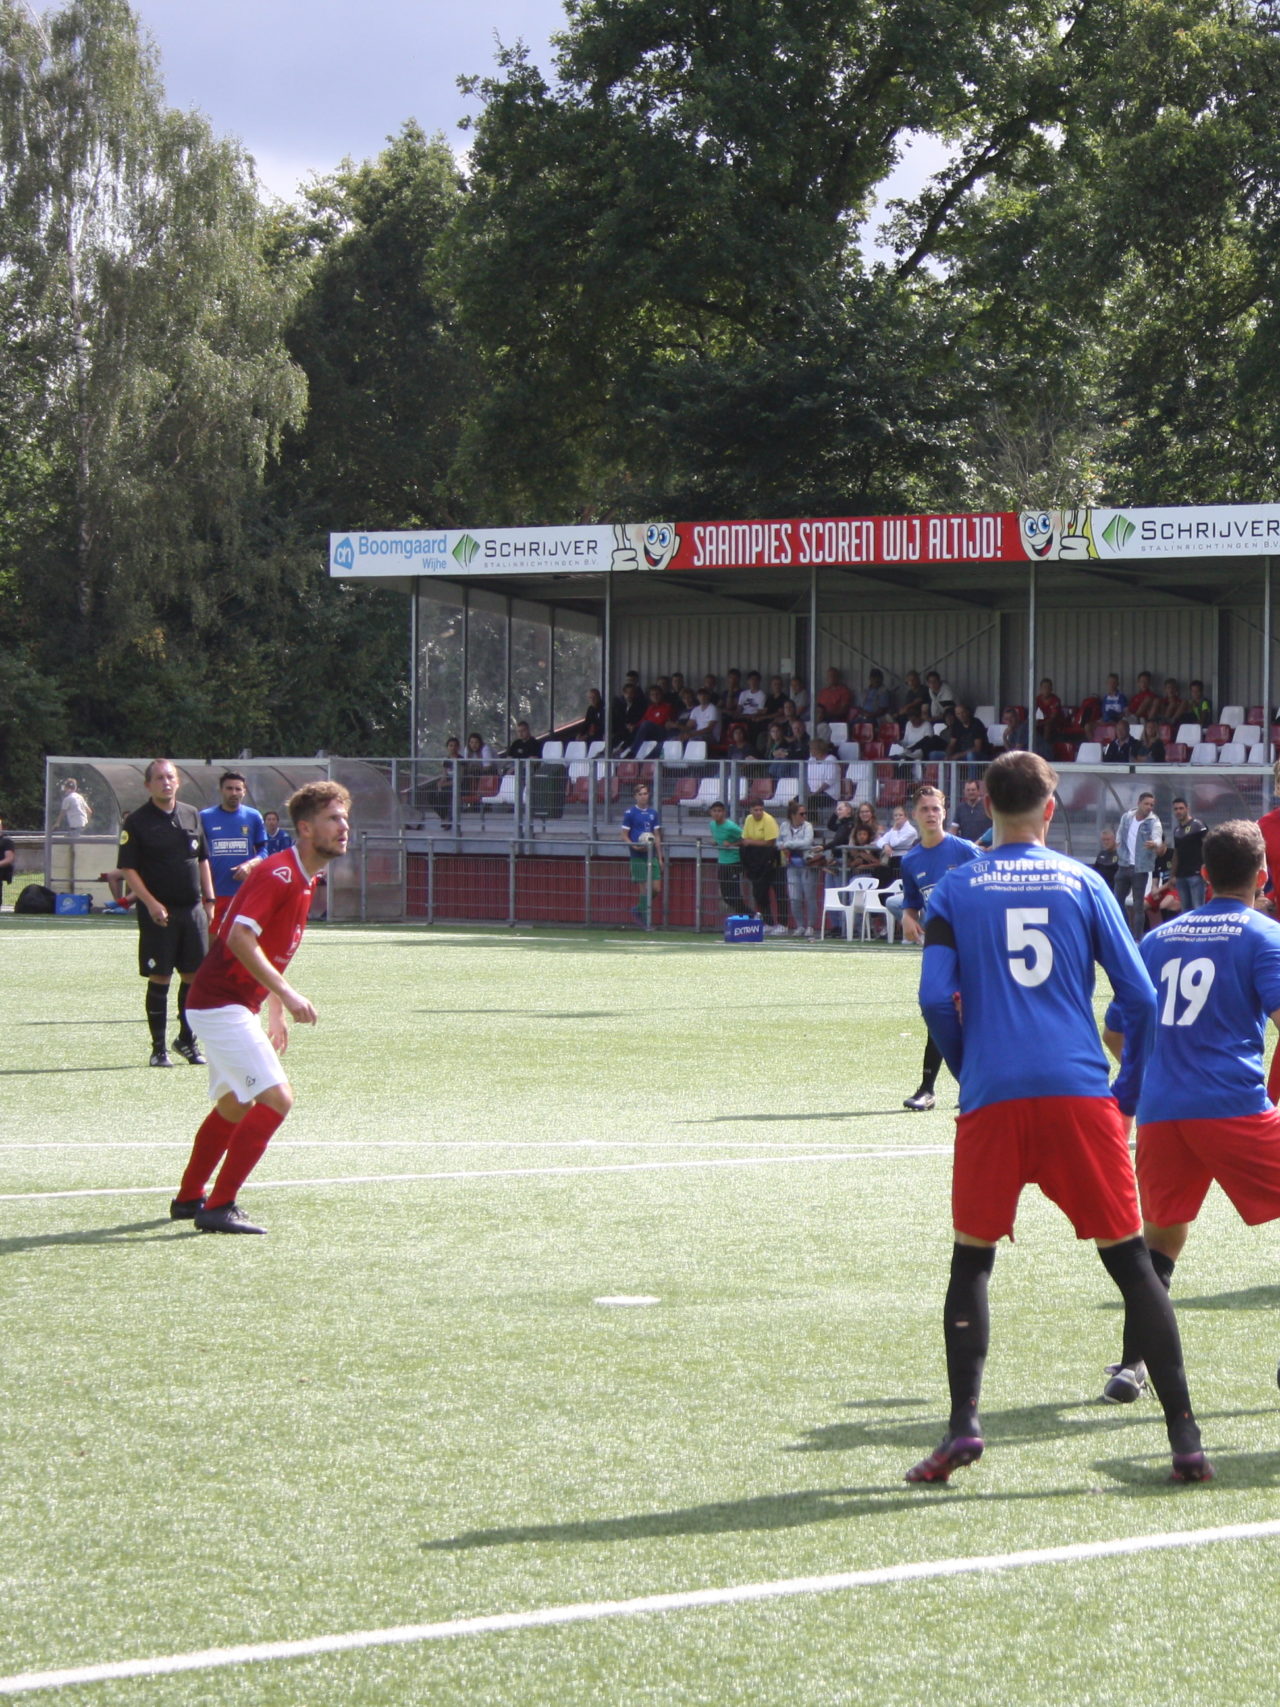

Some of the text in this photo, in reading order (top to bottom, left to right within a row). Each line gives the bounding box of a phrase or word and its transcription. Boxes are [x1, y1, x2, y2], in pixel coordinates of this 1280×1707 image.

[693, 516, 1003, 566] SAAMPIES SCOREN WIJ ALTIJD!
[1141, 519, 1280, 541] SCHRIJVER
[358, 534, 448, 560] Boomgaard
[484, 539, 599, 558] SCHRIJVER
[422, 558, 448, 571] Wijhe
[734, 925, 760, 936] EXTRAN
[1006, 907, 1053, 987] 5
[1161, 957, 1216, 1026] 19
